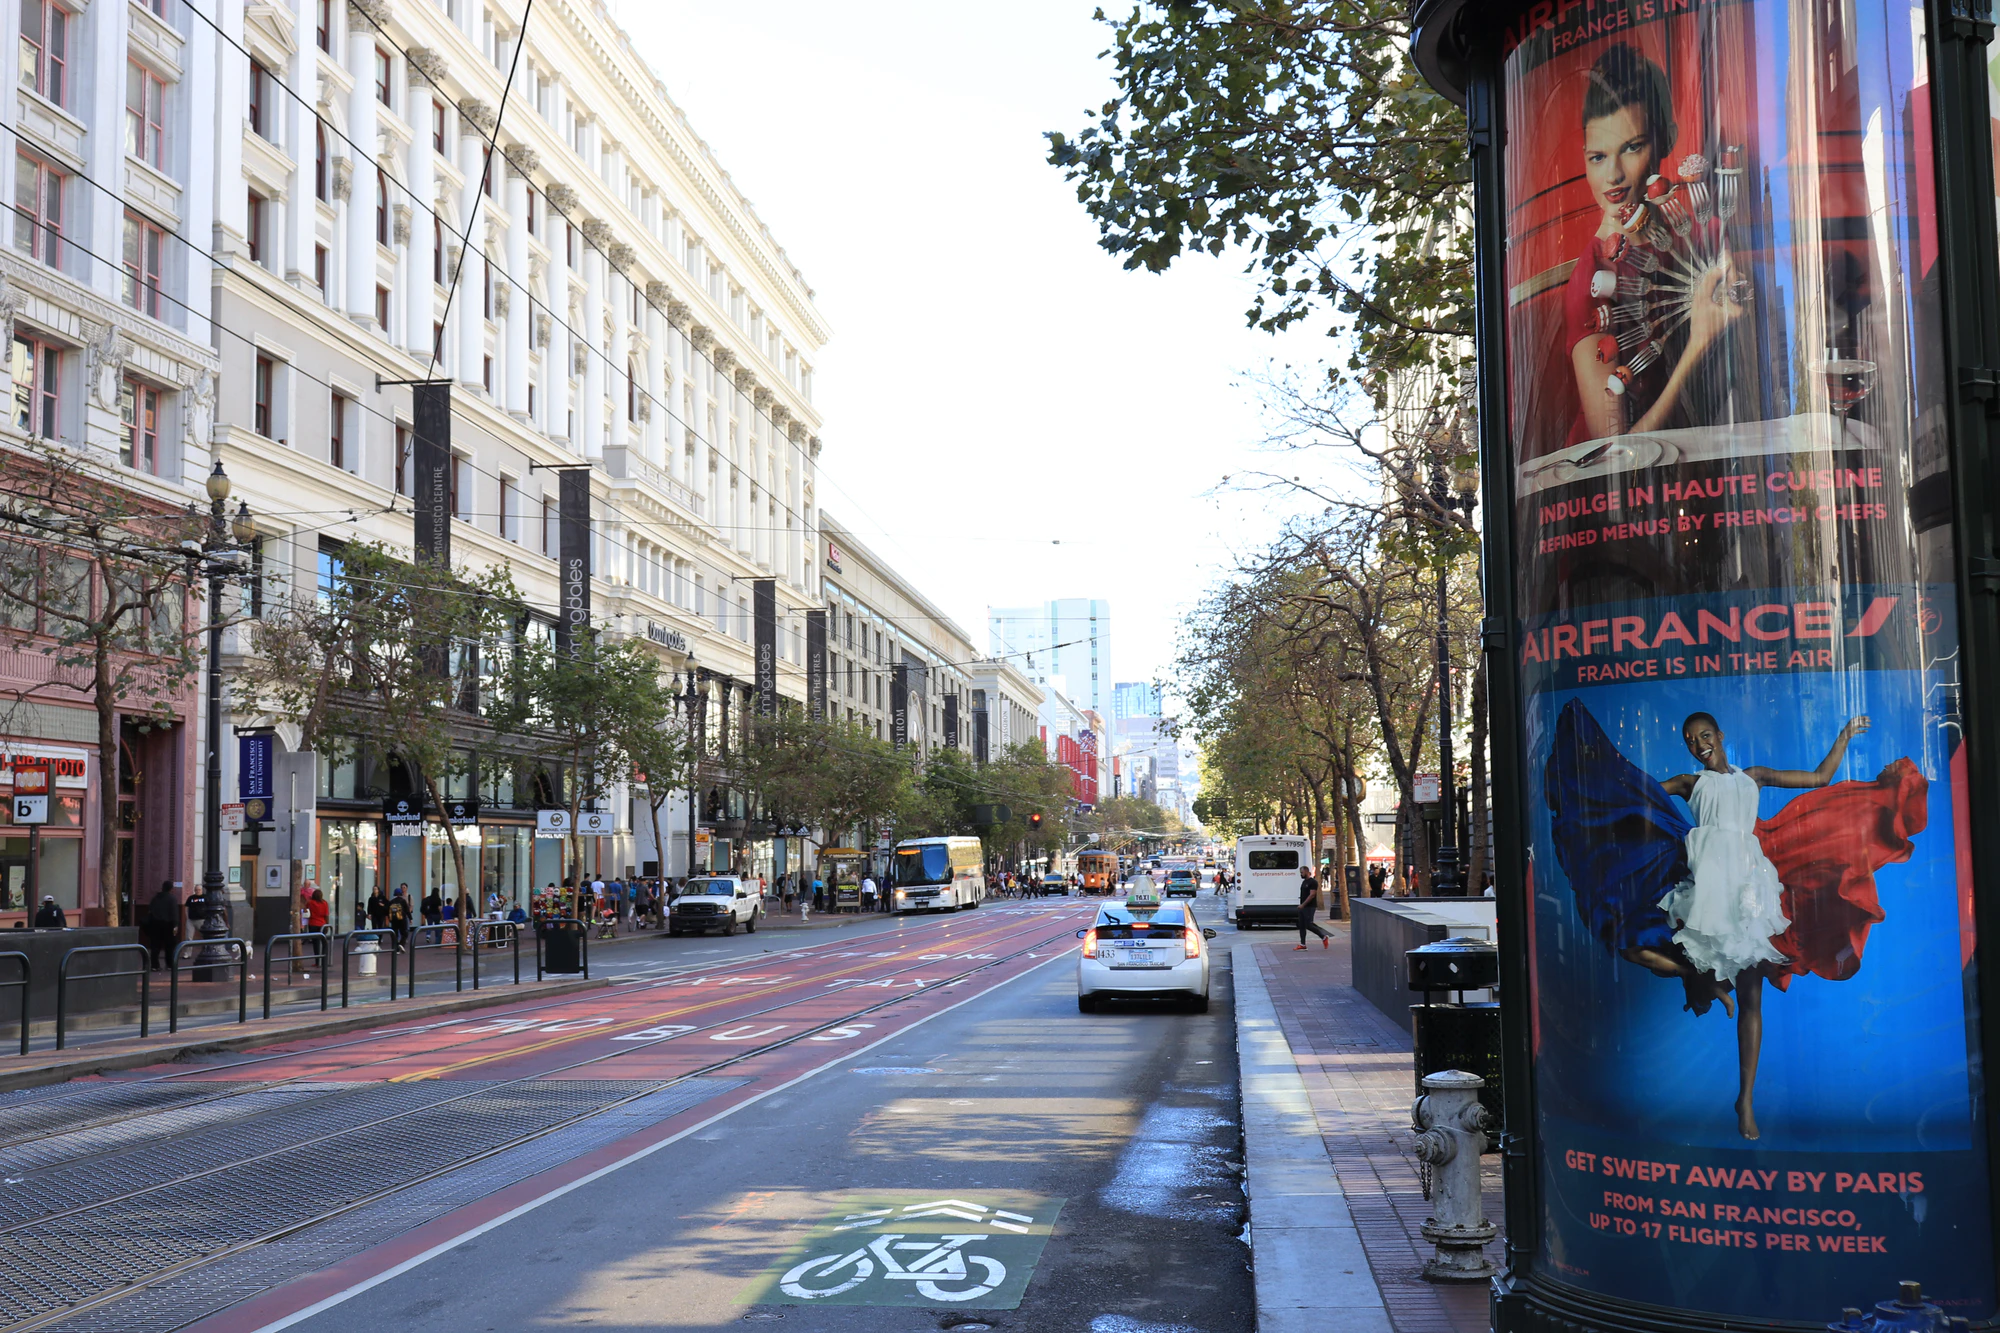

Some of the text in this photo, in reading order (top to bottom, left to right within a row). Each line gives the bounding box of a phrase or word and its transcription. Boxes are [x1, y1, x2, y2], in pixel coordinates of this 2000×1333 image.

[1552, 8, 1628, 52] FRANCE
[1636, 0, 1655, 21] IS
[433, 466, 443, 502] CENTRE
[1539, 467, 1883, 525] INDULGE IN HAUTE CUISINE
[1539, 503, 1887, 555] REFINED MENUS BY FRENCH CHEFS
[1522, 601, 1833, 666] AIRFRANCE
[1577, 649, 1833, 683] FRANCE IS IN THE AIR
[385, 812, 421, 821] Timberland
[449, 816, 476, 824] mberland
[918, 952, 1052, 961] ONLY
[824, 978, 969, 988] TAXI
[609, 1023, 876, 1042] BUS
[1565, 1149, 1924, 1194] GET SWEPT AWAY BY PARIS
[1603, 1191, 1862, 1231] FROM SAN FRANCISCO,
[1589, 1211, 1888, 1254] UP TO 17 FLIGHTS PER WEEK
